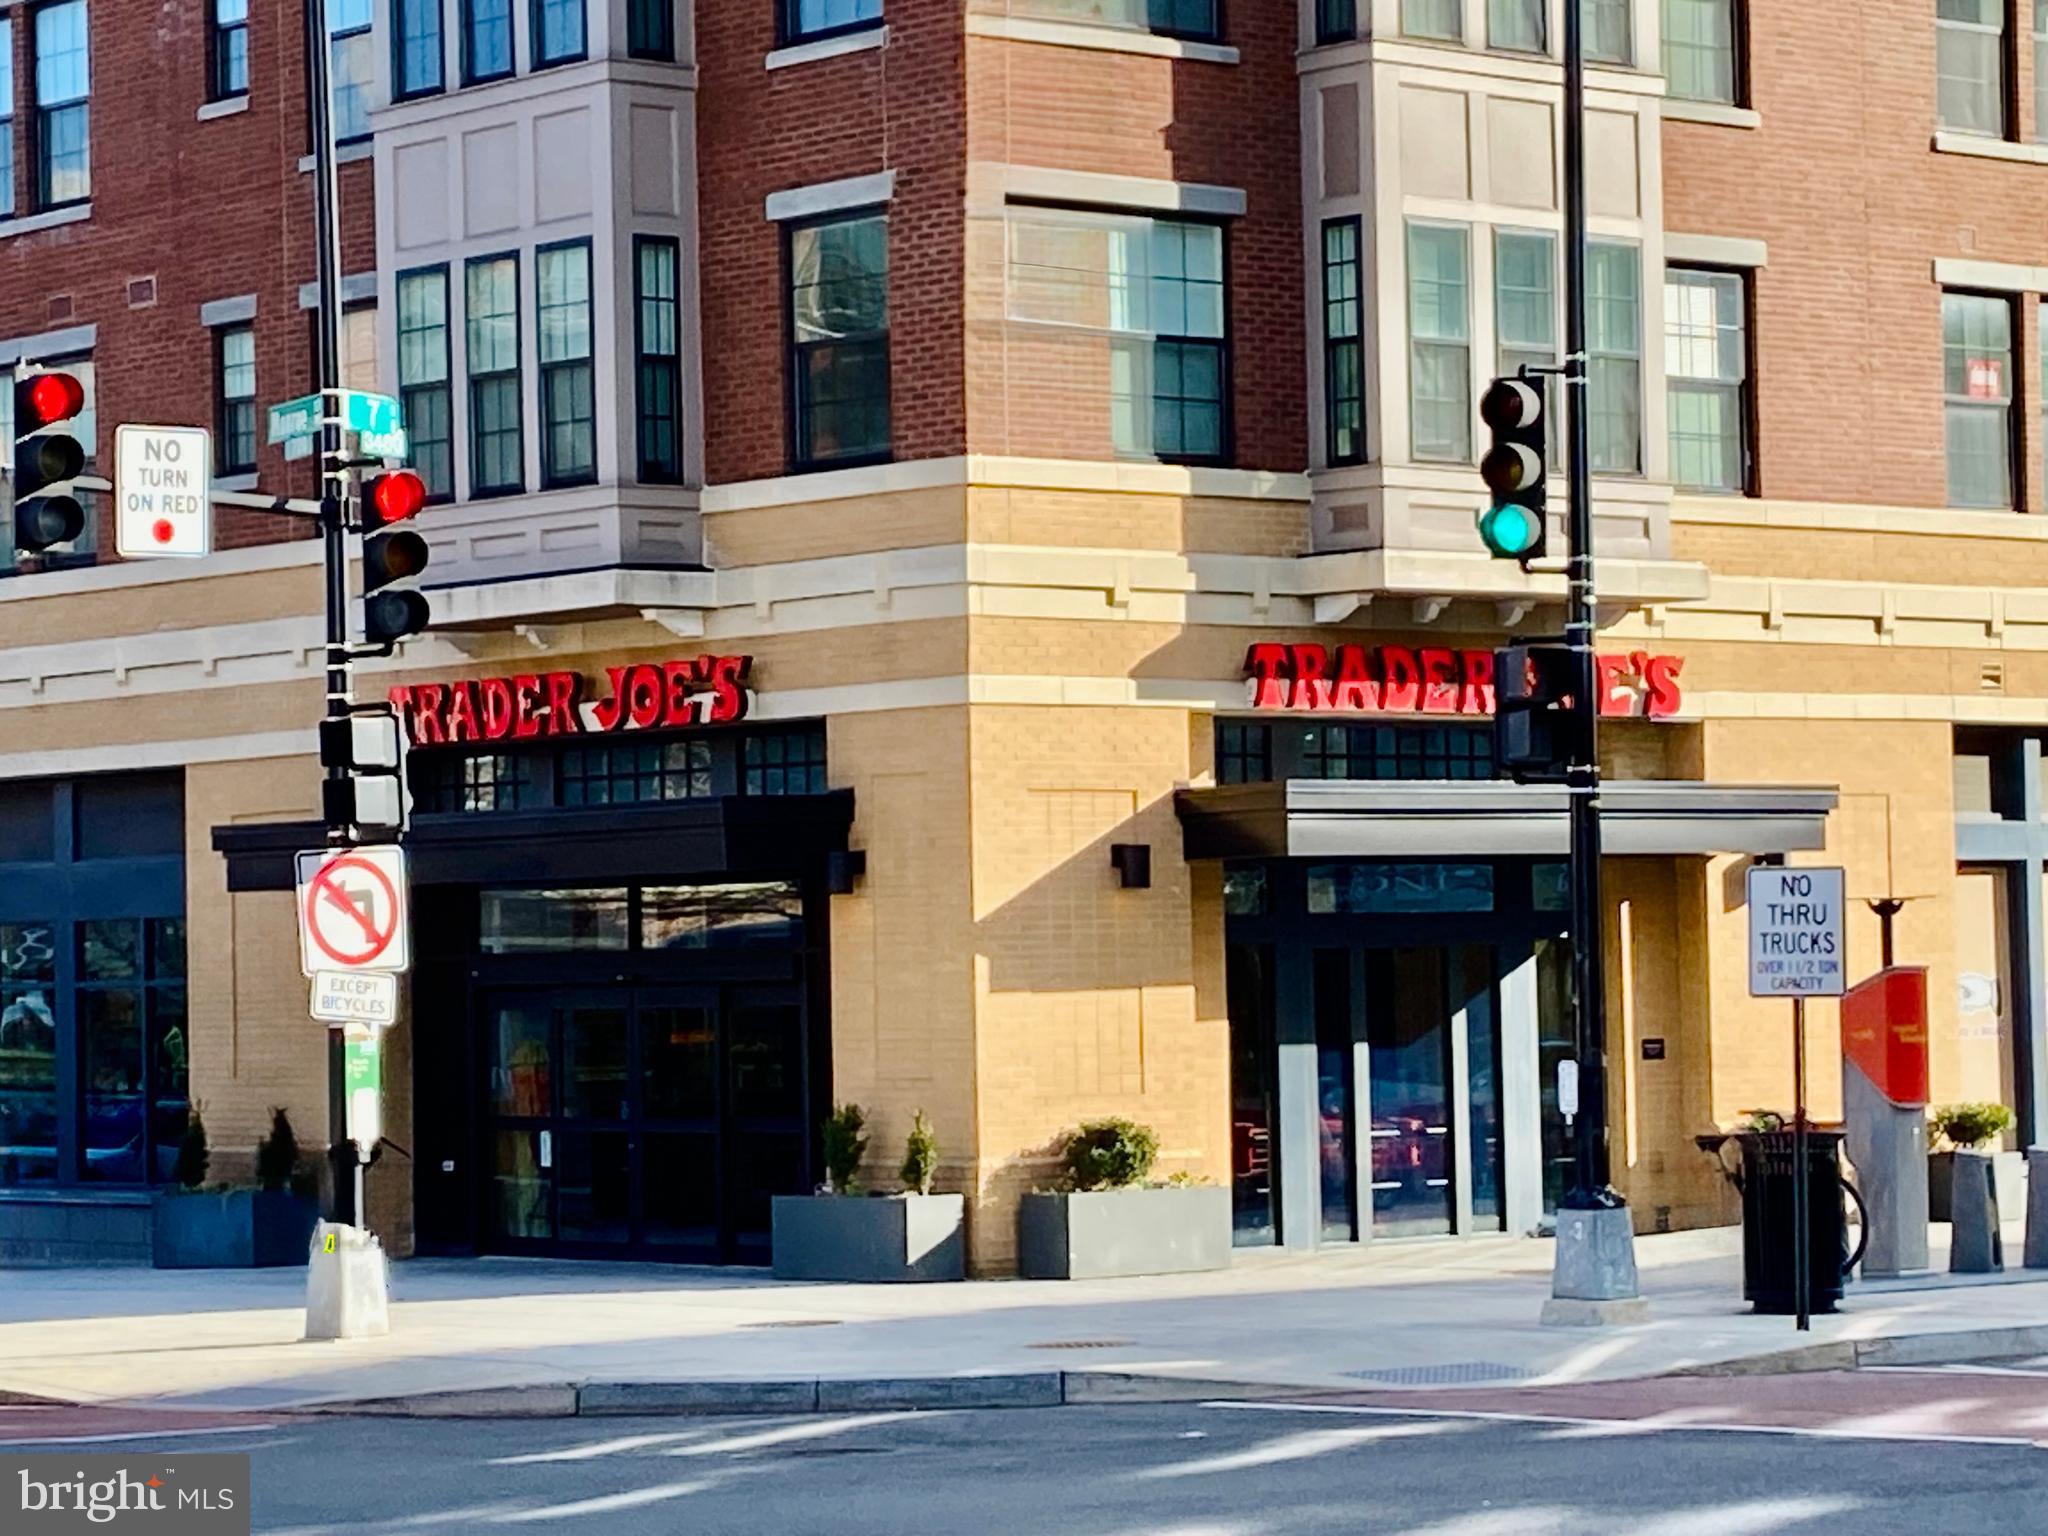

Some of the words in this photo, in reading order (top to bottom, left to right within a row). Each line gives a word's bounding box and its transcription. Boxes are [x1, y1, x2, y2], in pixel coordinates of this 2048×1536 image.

[144, 438, 181, 462] NO
[139, 467, 188, 488] TURN
[127, 493, 153, 512] ON
[162, 494, 198, 514] RED
[1244, 643, 1495, 714] TRADER
[388, 670, 586, 745] TRADER
[592, 655, 752, 732] JOE'S
[1781, 875, 1812, 897] NO
[1767, 903, 1827, 925] THRU
[1760, 932, 1835, 954] TRUCKS
[1757, 960, 1783, 974] OVER
[330, 978, 378, 995] EXCEPT
[1770, 976, 1824, 990] CAPACITY
[322, 995, 386, 1013] BICYCLES
